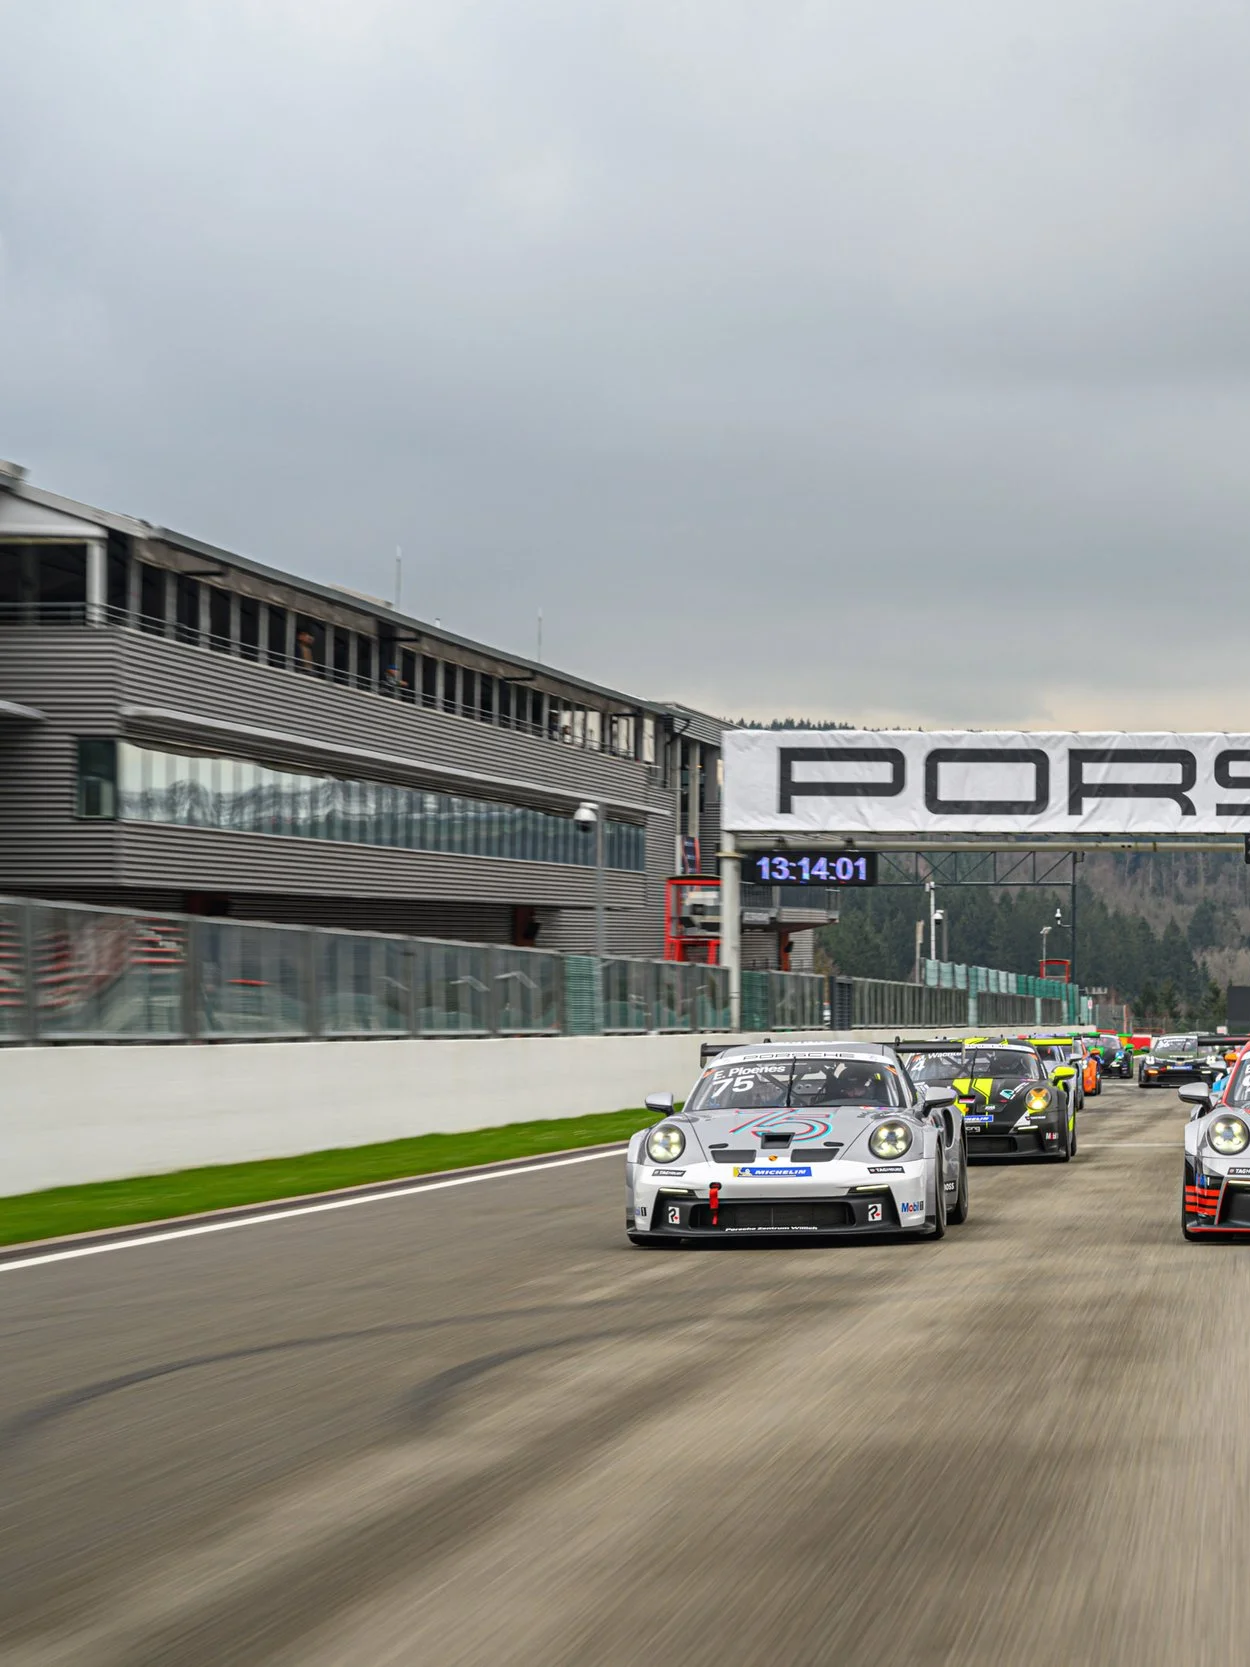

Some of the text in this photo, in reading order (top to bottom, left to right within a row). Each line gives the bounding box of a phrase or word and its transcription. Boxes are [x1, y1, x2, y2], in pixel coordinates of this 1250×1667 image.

[756, 856, 867, 881] 13:14:01
[713, 1065, 786, 1081] E. Ploenes
[911, 1058, 925, 1071] 4
[711, 1075, 754, 1099] 75
[730, 1108, 833, 1143] 75
[901, 1202, 919, 1213] Mobil
